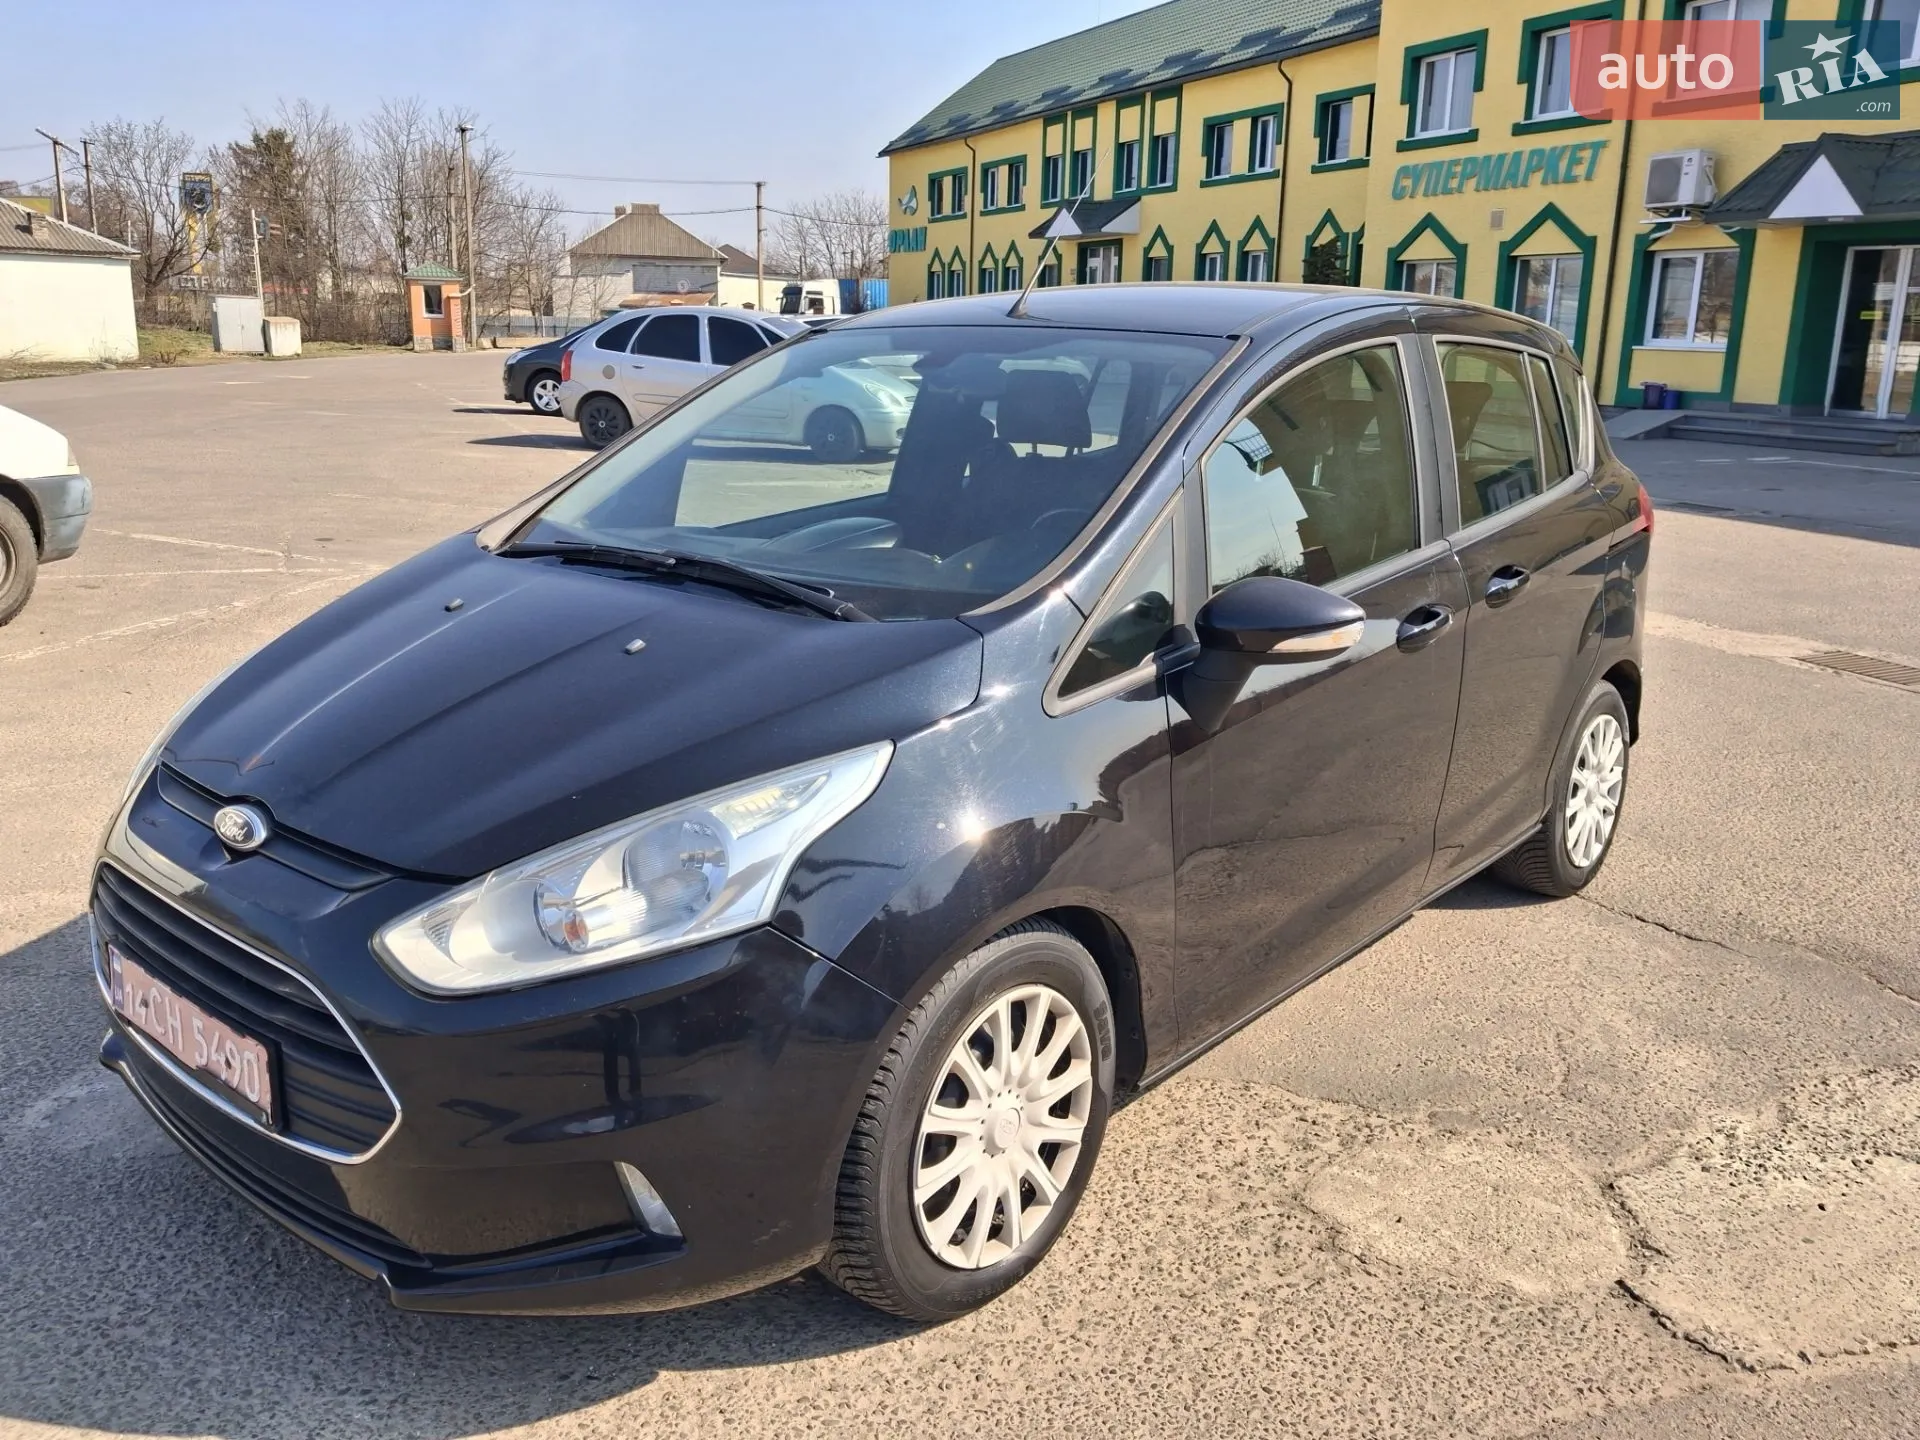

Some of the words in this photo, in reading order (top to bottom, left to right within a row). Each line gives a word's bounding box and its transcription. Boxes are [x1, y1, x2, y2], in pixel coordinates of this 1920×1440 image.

[1391, 140, 1611, 200] СУПЕРМАРКЕТ
[220, 813, 248, 842] Ford
[192, 1016, 261, 1103] 5490
